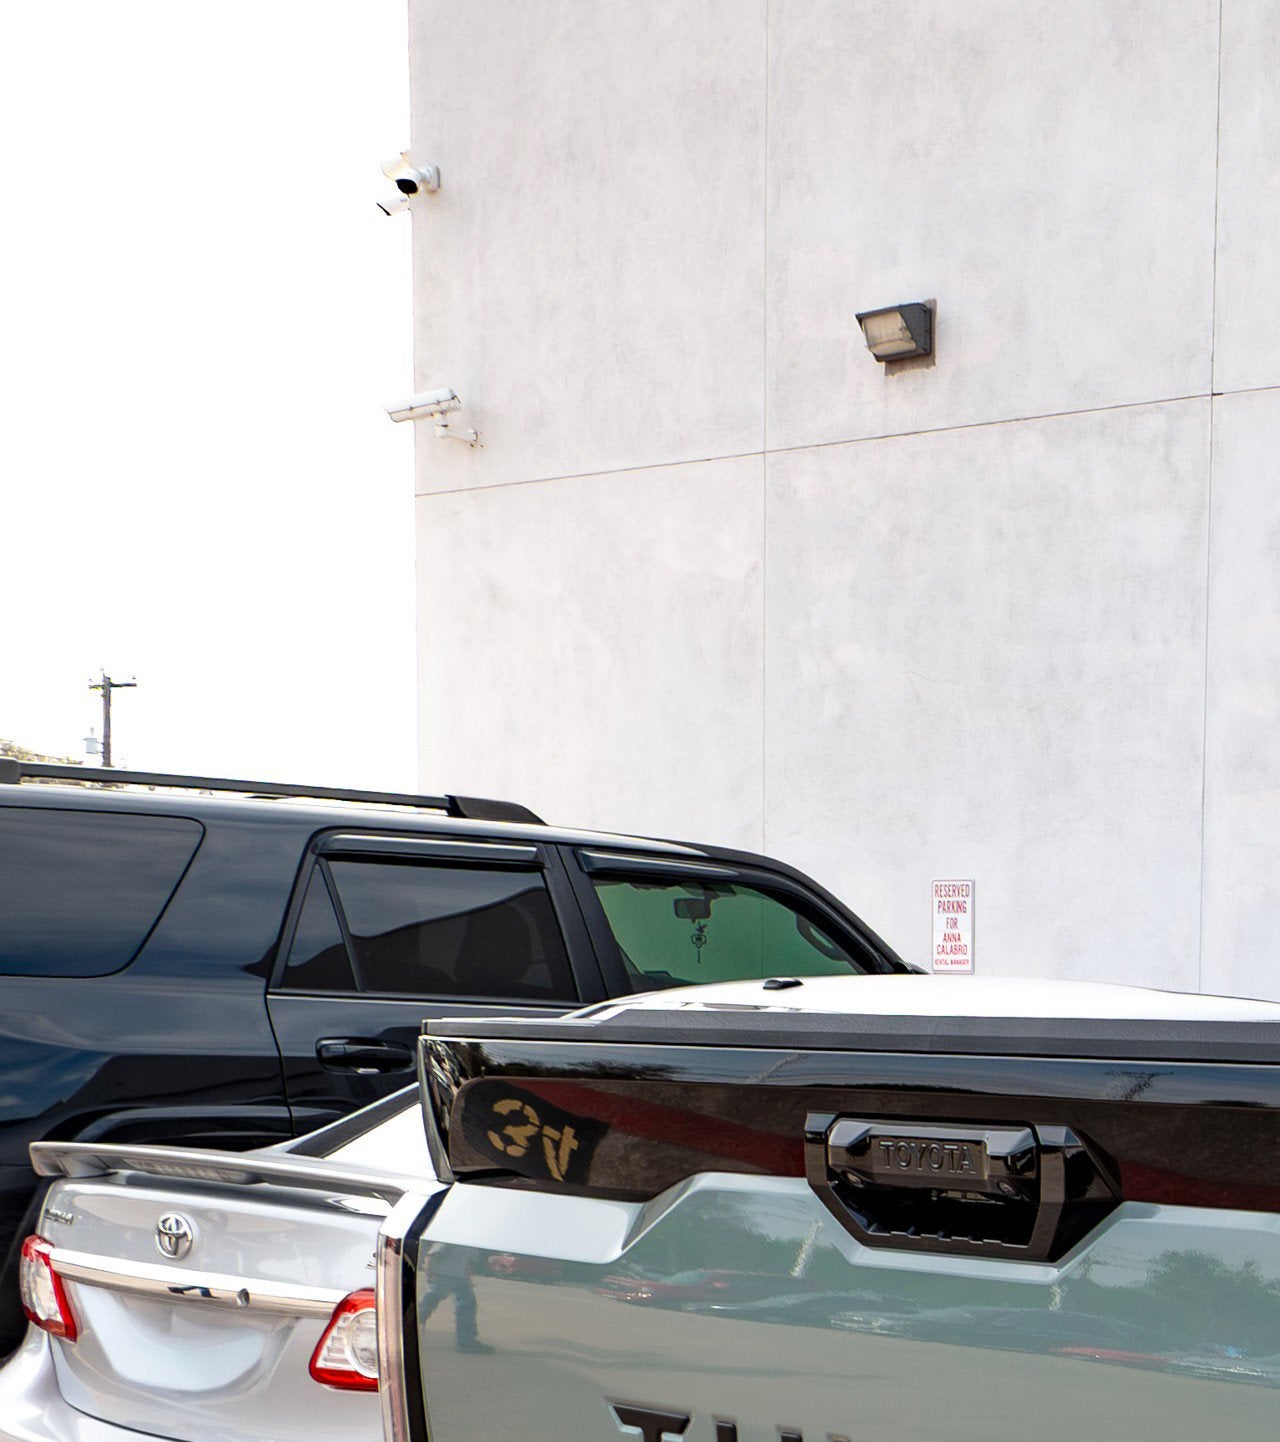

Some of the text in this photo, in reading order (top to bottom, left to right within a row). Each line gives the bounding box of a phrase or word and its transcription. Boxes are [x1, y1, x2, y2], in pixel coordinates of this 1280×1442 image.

[935, 884, 970, 897] RESERVED
[938, 901, 967, 914] PARKING
[946, 918, 958, 930] FOR
[943, 933, 961, 942] ANNA
[878, 1140, 977, 1176] TOYOTA
